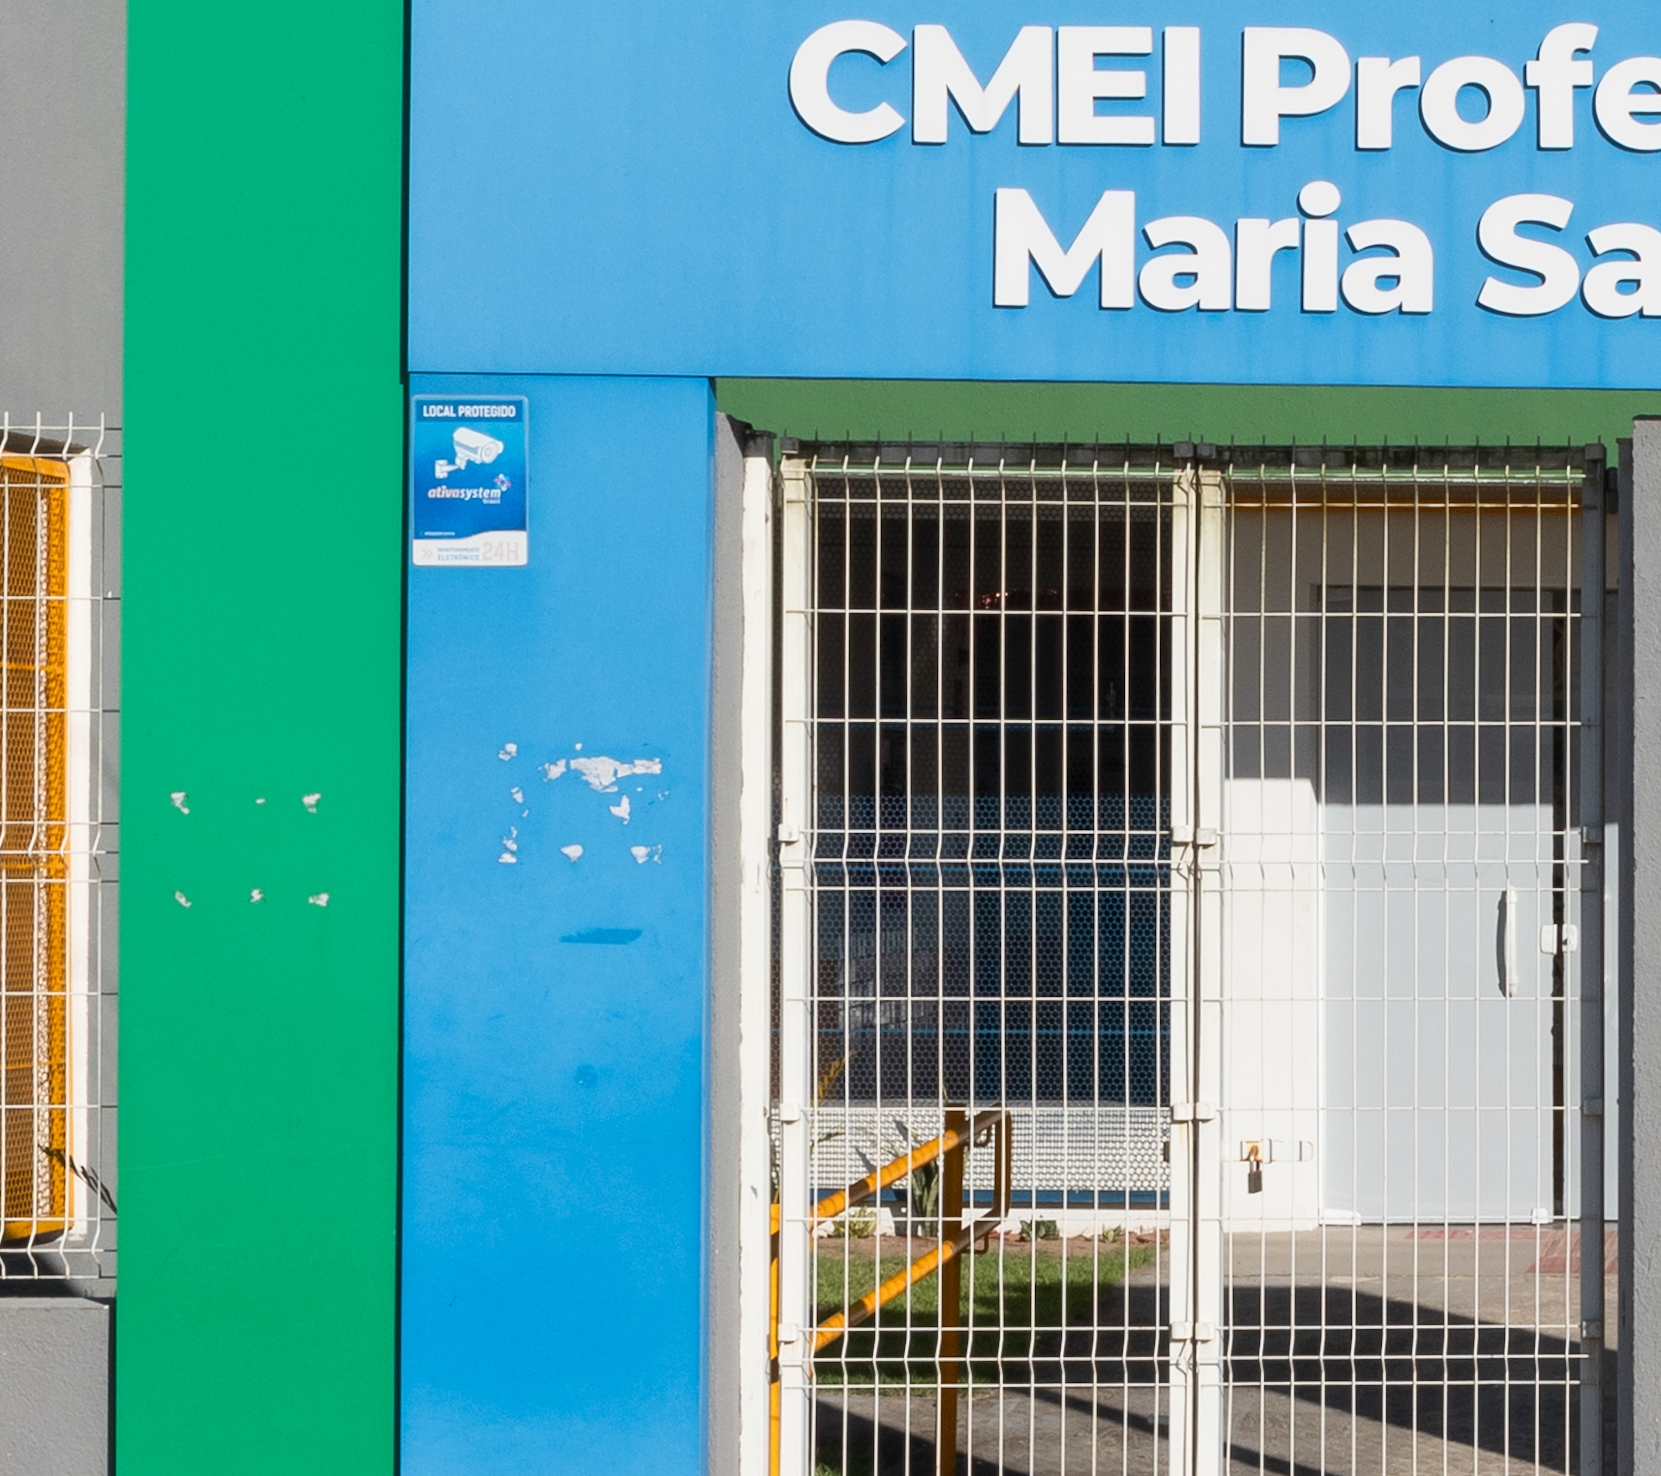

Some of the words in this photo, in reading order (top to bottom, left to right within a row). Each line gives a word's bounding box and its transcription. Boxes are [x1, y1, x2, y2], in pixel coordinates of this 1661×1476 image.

[789, 18, 1203, 146] CMEI
[994, 179, 1436, 315] Maria
[422, 404, 457, 418] LOCAL
[457, 404, 517, 418] PROTEGIDO
[482, 541, 519, 561] 24H
